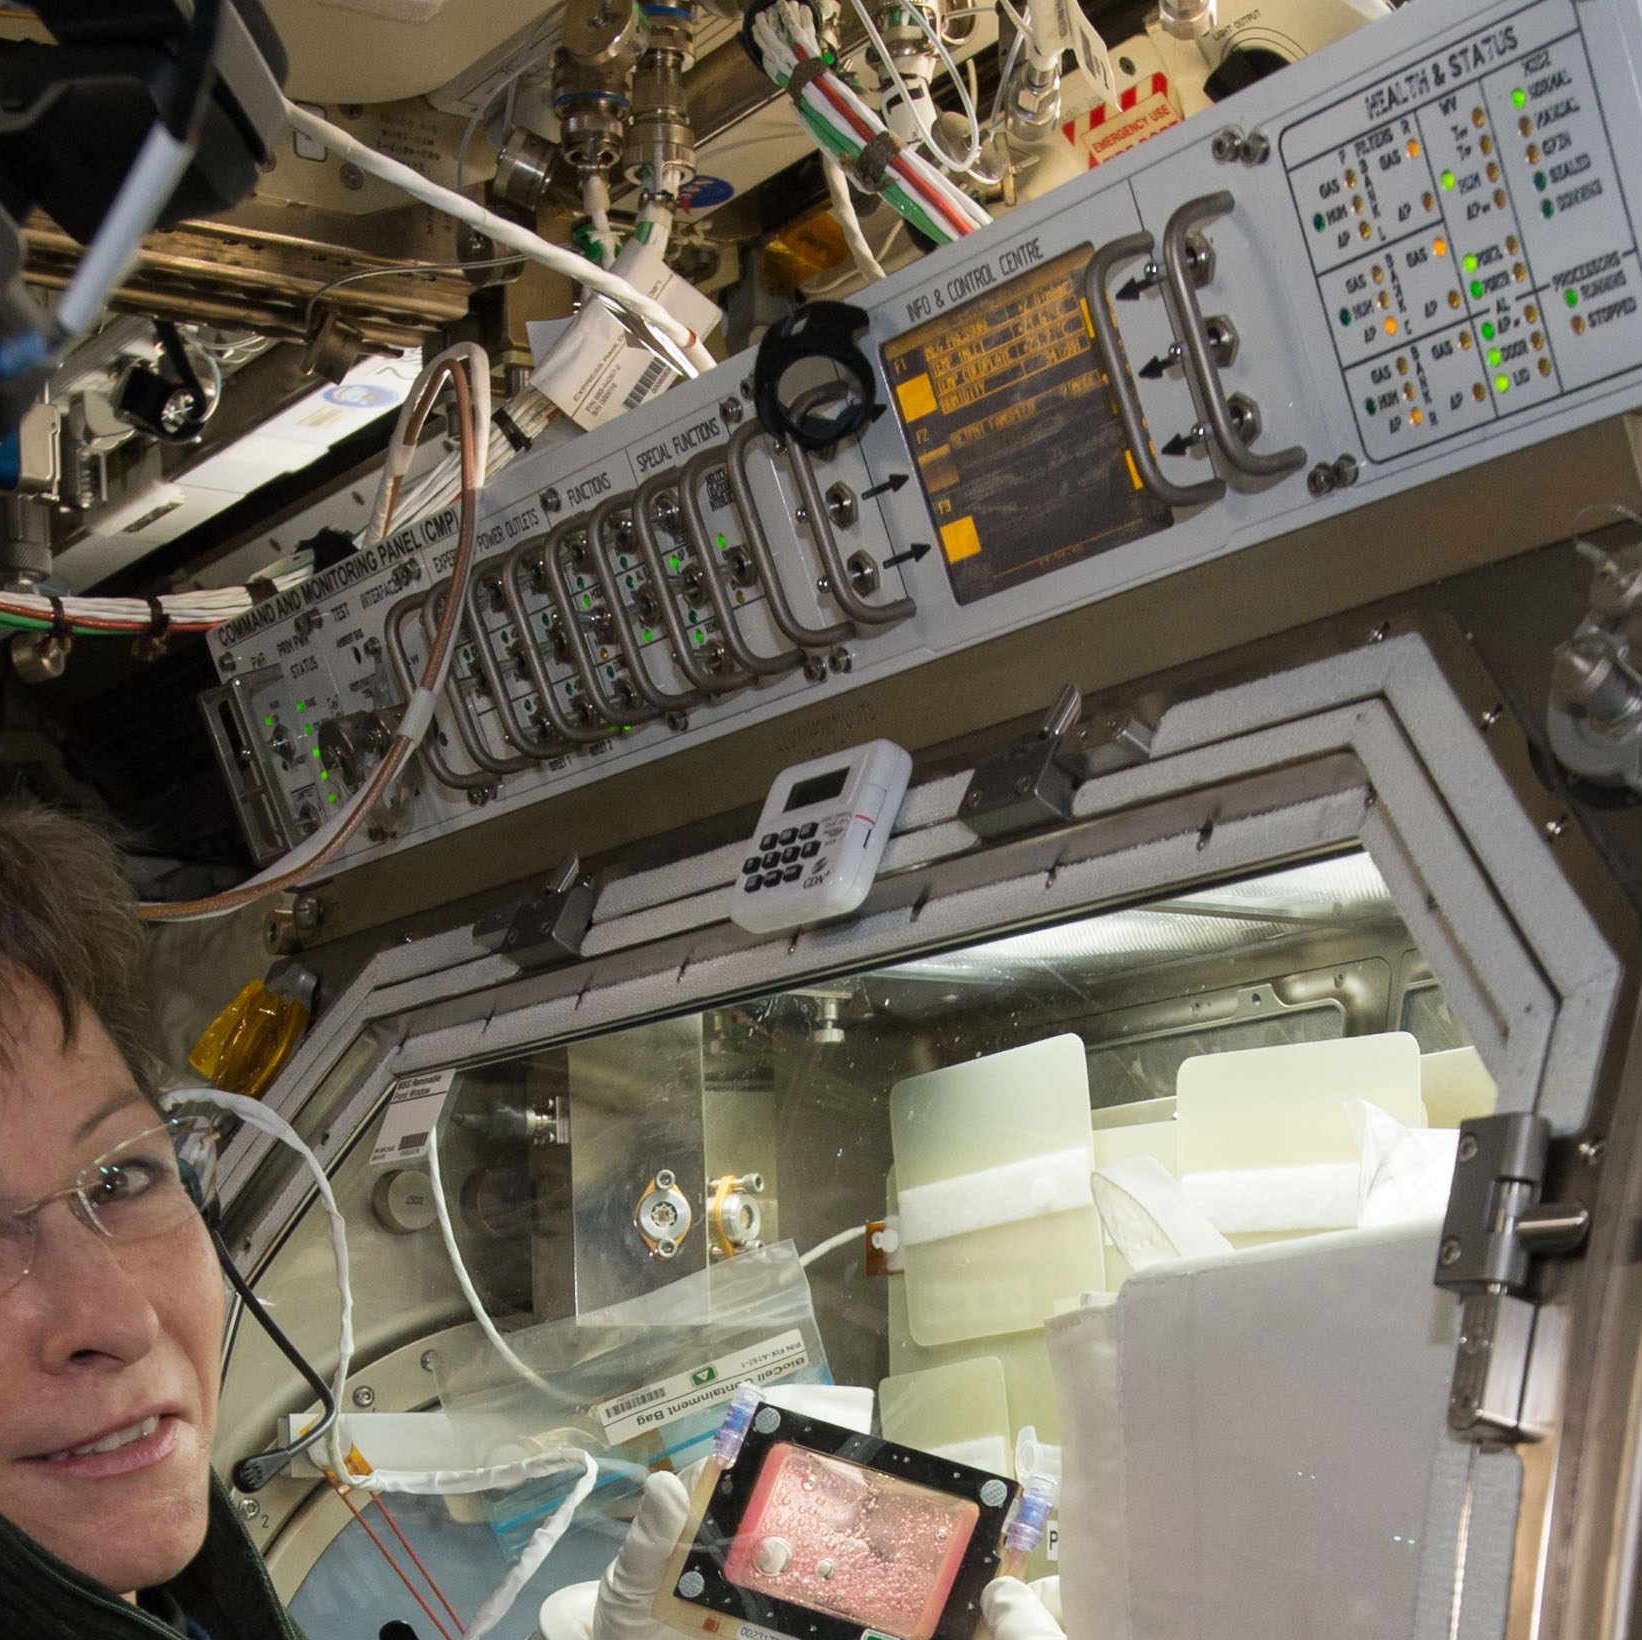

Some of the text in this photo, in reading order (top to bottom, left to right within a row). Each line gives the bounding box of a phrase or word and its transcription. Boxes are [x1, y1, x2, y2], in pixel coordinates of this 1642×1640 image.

[1233, 8, 1260, 30] OUTPUT
[1363, 24, 1519, 121] HEALTH & STATUS
[1092, 116, 1149, 154] EMERGENCY
[1148, 103, 1169, 122] USE
[1378, 148, 1402, 171] GAS
[1318, 177, 1340, 199] GAS
[907, 298, 931, 322] INFO
[934, 289, 945, 307] &
[947, 265, 996, 302] CONTROL
[1000, 238, 1044, 276] CENTRE
[1586, 294, 1637, 330] STOPPED
[1430, 338, 1453, 360] GAS
[1370, 364, 1392, 385] GAS
[635, 417, 721, 472] SPECIAL FUNCTIONS
[566, 472, 612, 507] FUNCTIONS
[476, 507, 540, 552] POWER OUTLETS
[217, 505, 459, 648] COMMAND AND MONITORING PANEL (CMP)
[332, 602, 350, 623] TEST
[277, 638, 294, 656] PRIM
[290, 654, 318, 680] STATUS
[785, 1341, 801, 1353] P/N
[756, 1355, 806, 1382] BioCell
[635, 1408, 664, 1427] Bag
